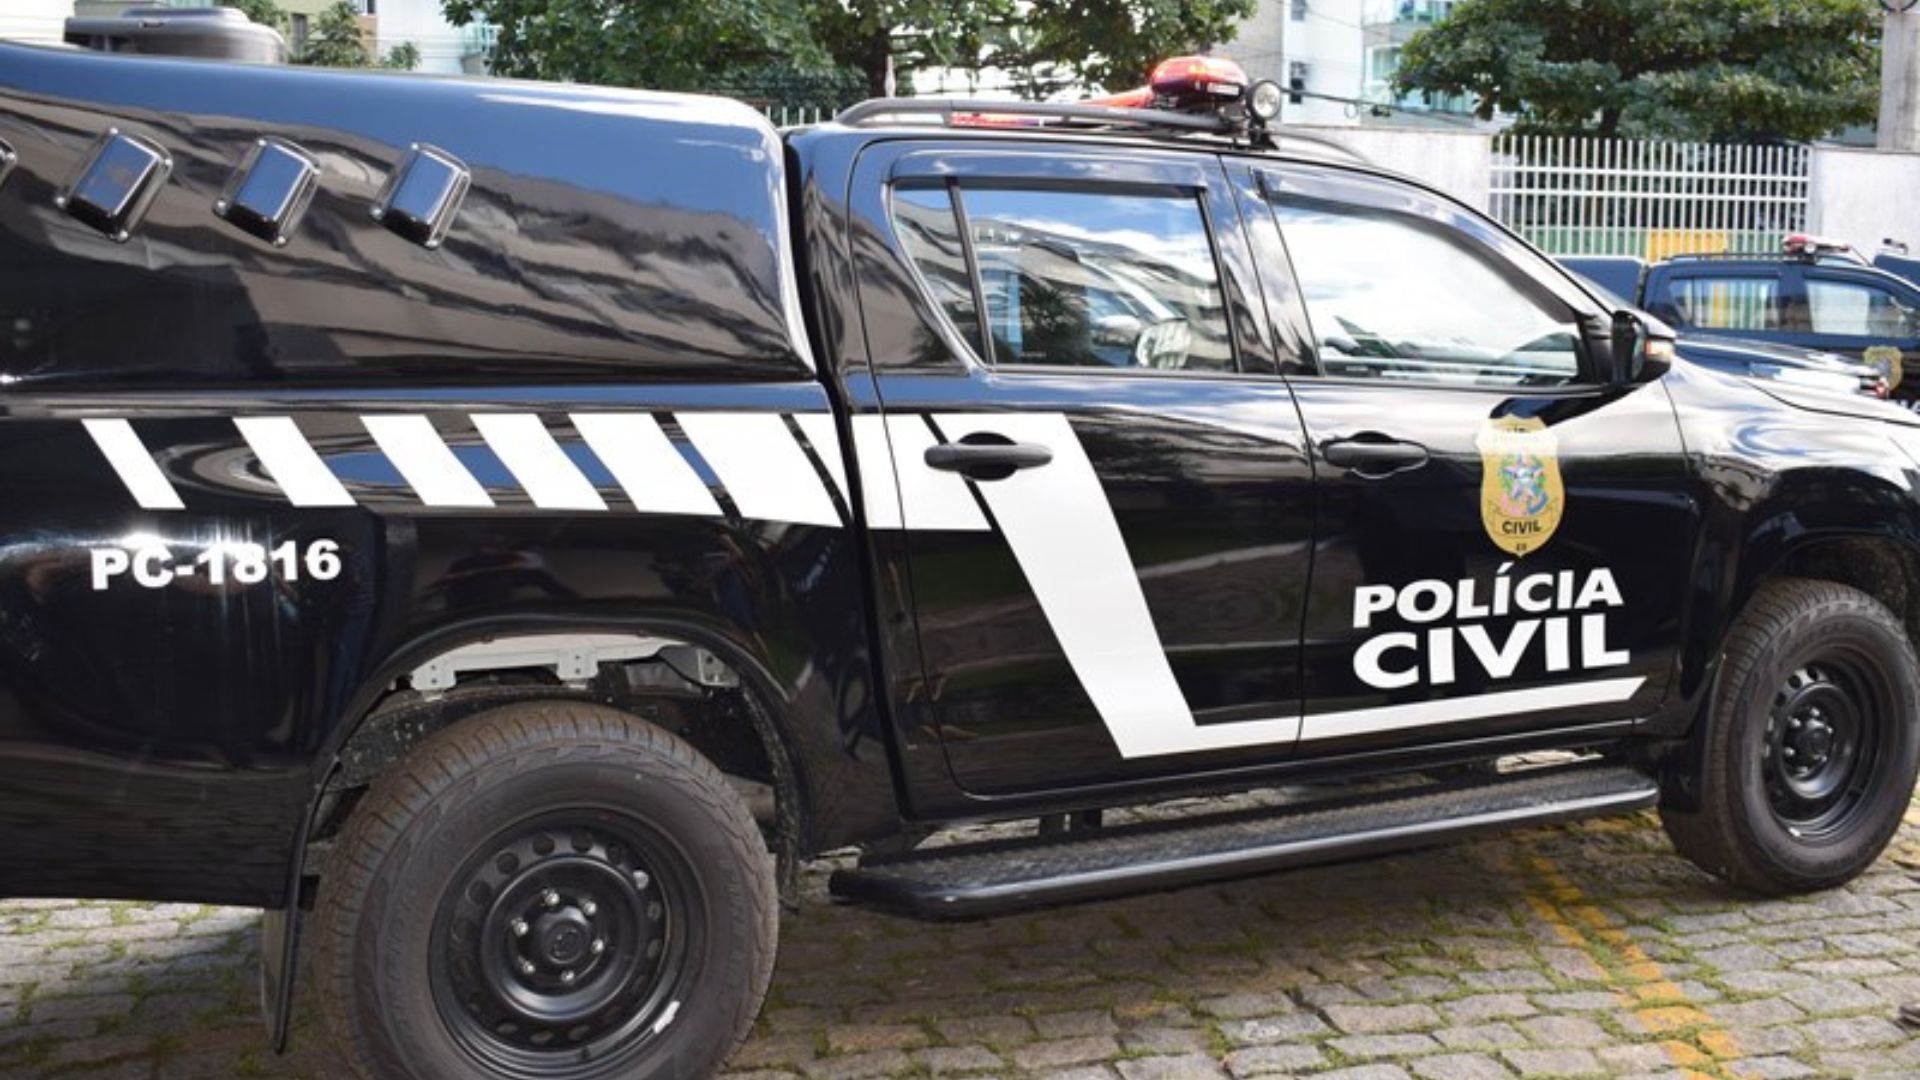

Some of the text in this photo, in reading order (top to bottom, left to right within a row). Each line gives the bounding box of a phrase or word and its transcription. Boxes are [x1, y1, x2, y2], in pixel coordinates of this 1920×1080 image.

[1502, 520, 1541, 535] CIVIL
[91, 538, 342, 591] PC-1816
[1353, 561, 1624, 629] POLÍCIA
[1352, 613, 1630, 689] CIVIL
